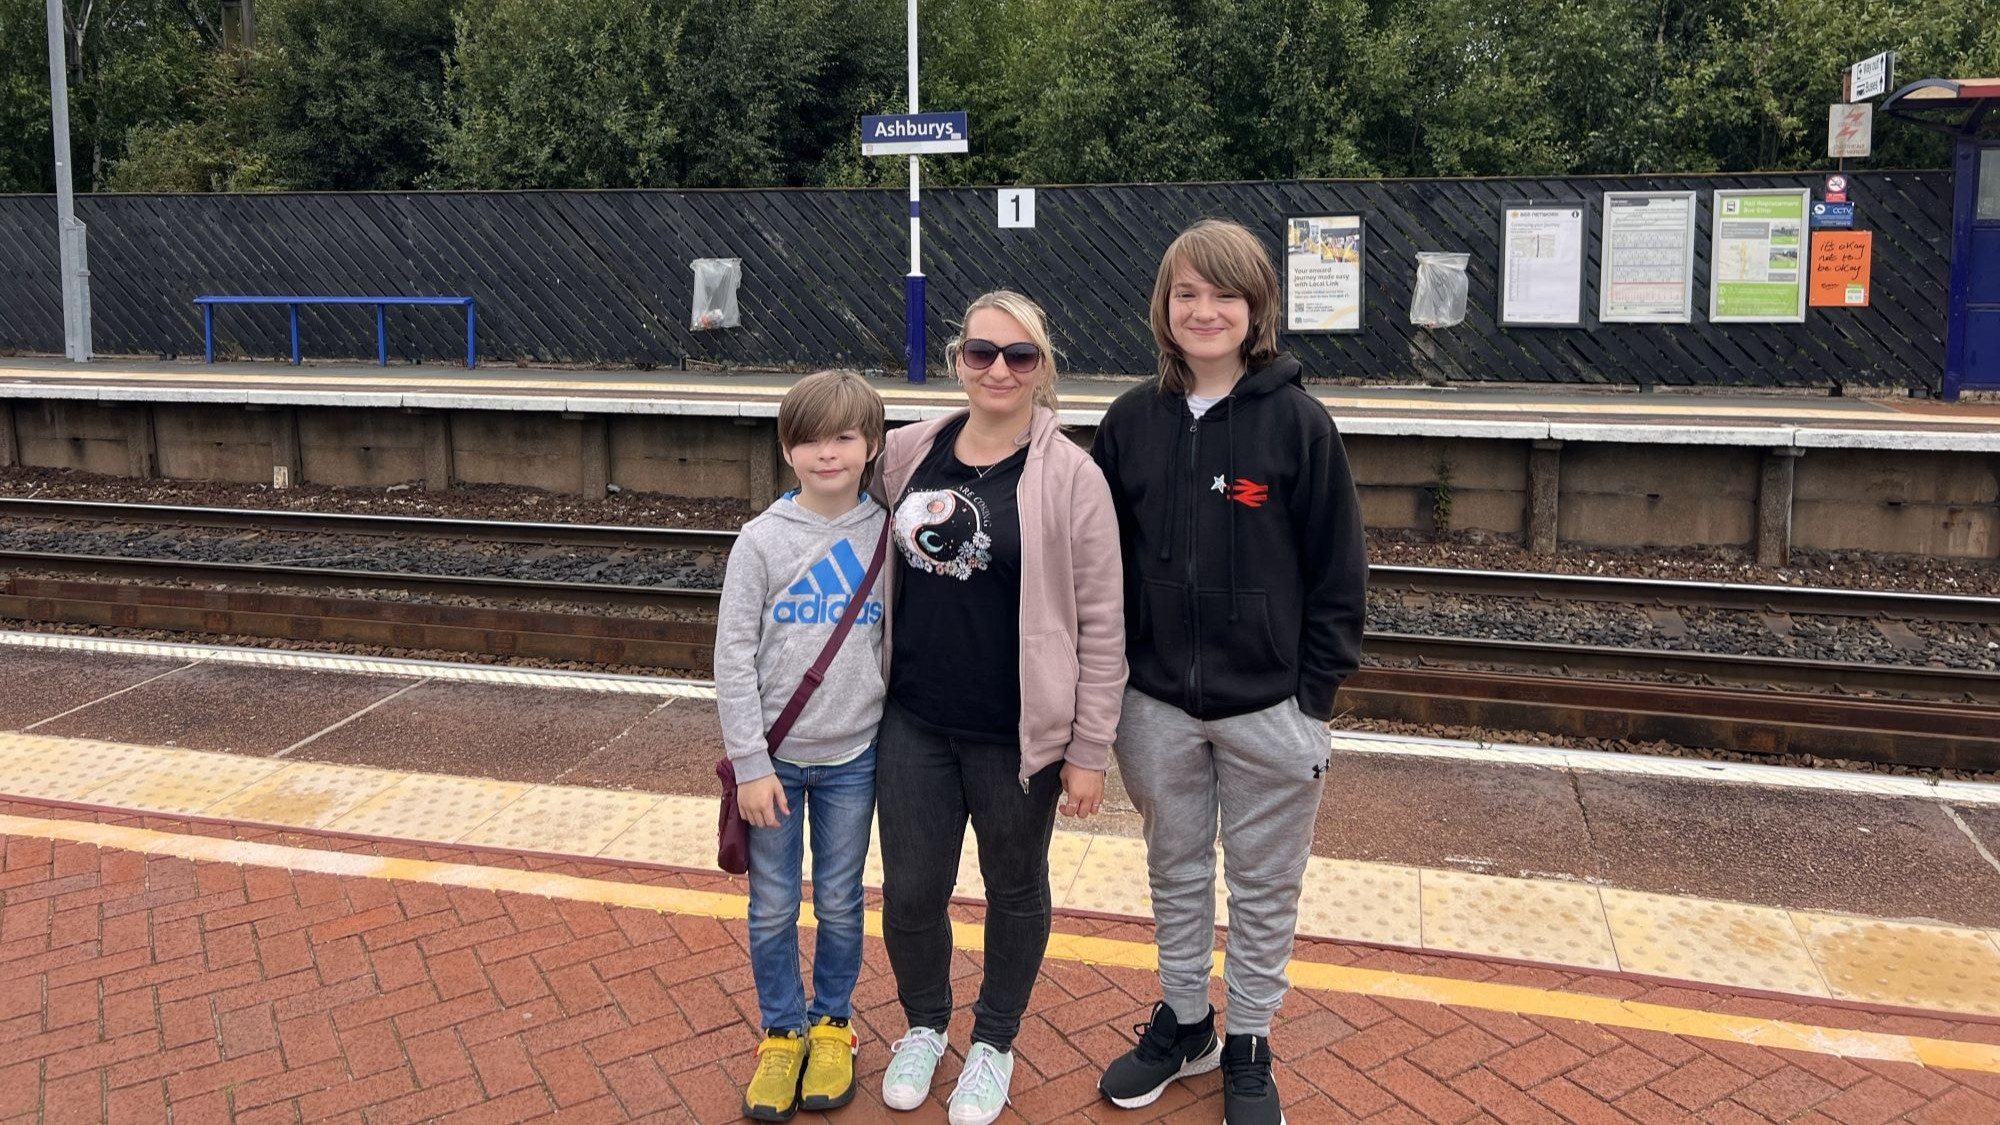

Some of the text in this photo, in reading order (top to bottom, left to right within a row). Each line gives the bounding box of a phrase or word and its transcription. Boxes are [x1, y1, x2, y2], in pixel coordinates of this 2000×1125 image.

[1865, 80, 1879, 93] Buses
[874, 119, 954, 139] Ashburys
[1010, 194, 1020, 222] 1
[1819, 253, 1854, 262] not to
[1817, 264, 1831, 272] be
